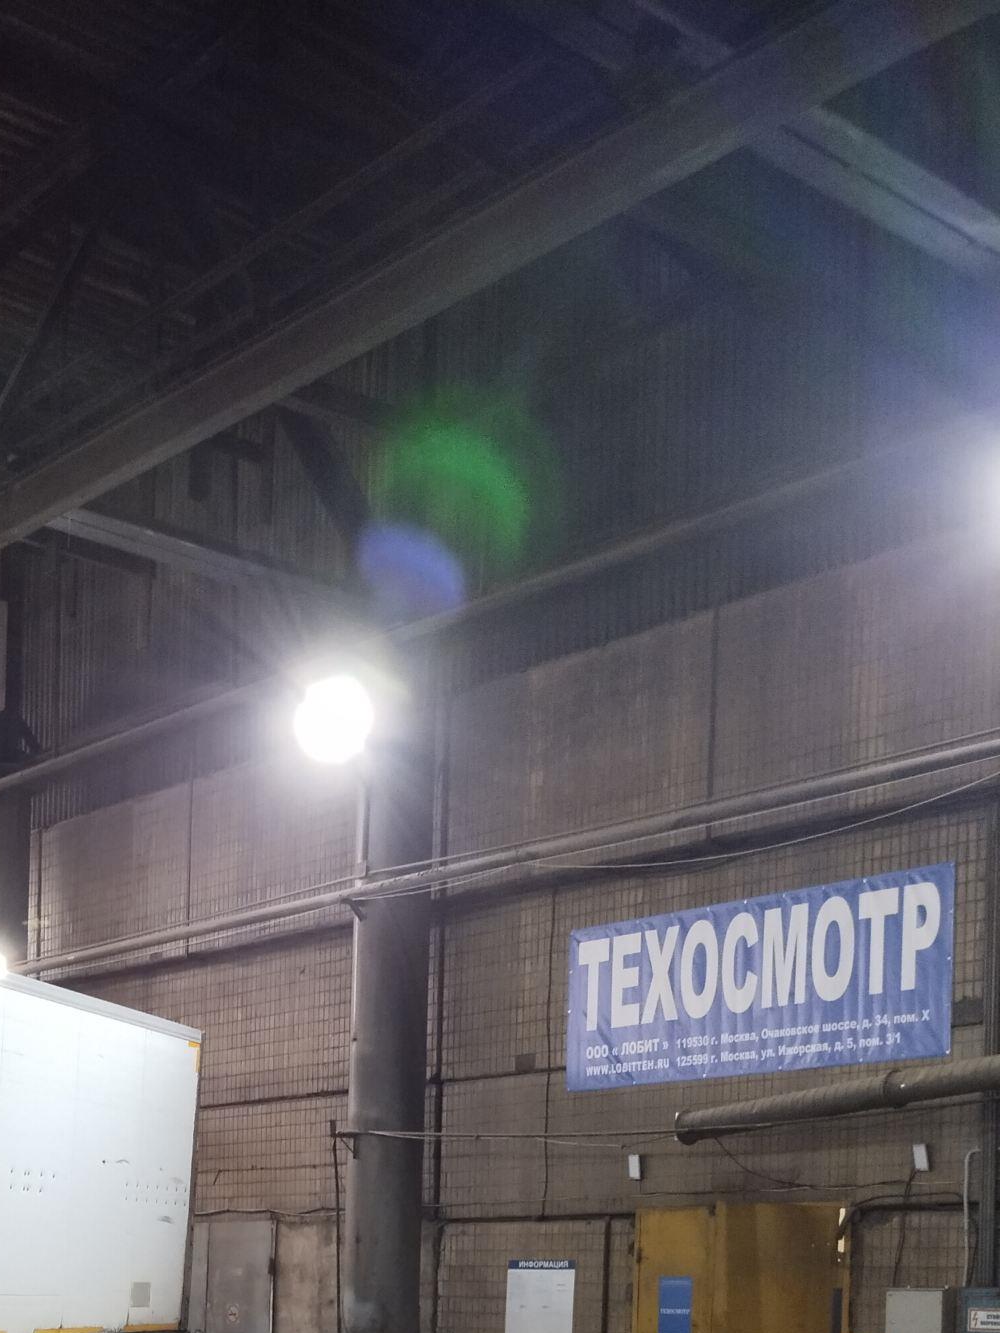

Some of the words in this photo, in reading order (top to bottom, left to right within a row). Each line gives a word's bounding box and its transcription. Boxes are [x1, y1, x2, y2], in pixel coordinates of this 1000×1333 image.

[578, 882, 941, 1031] ТЕХОСМОТР
[720, 1031, 760, 1044] Москва,
[761, 1024, 820, 1039] Очаковское
[822, 1018, 860, 1032] шоссе,
[893, 1013, 918, 1025] пом.
[586, 1044, 609, 1059] ООО
[620, 1038, 660, 1056] ЛОБИТ
[720, 1049, 759, 1063] Москва,
[858, 1036, 883, 1047] пом.
[518, 1260, 569, 1270] ИНФОРМАЦИЯ
